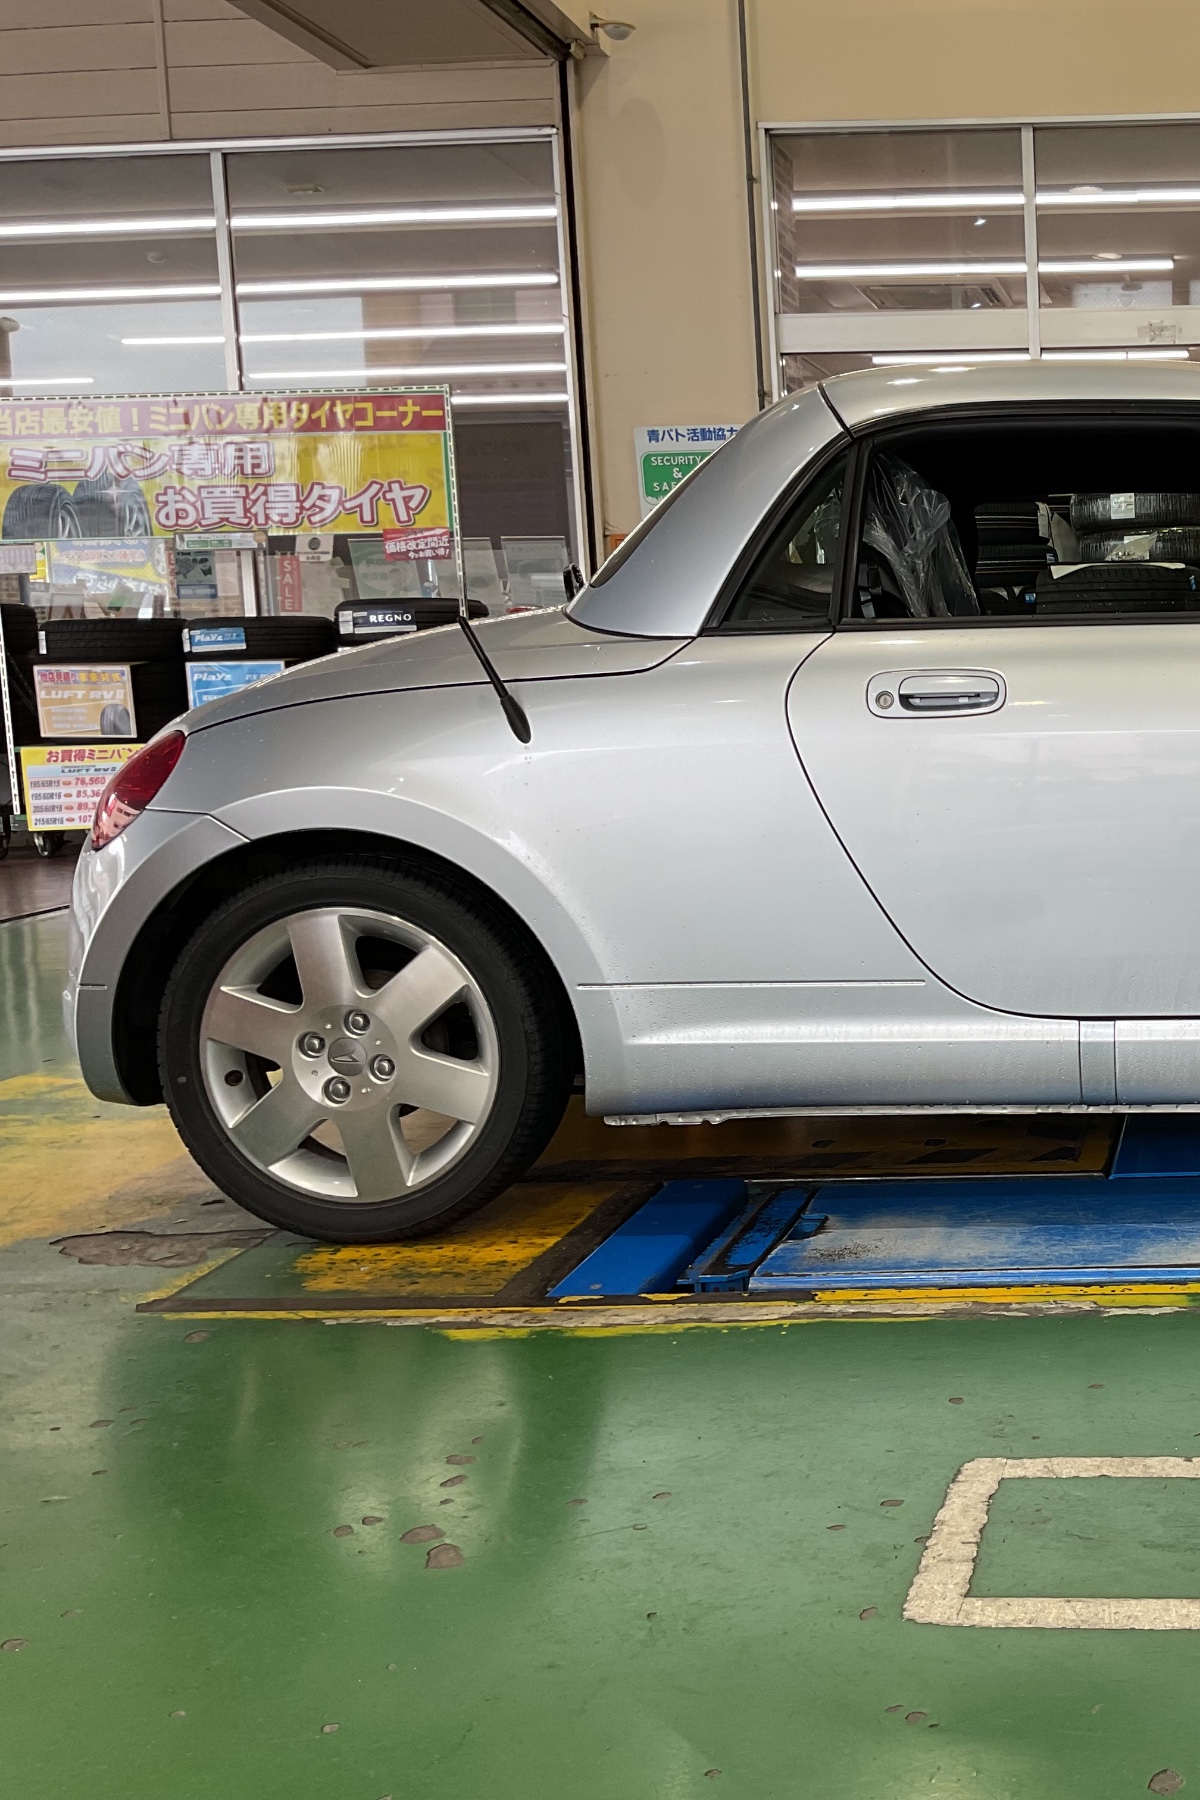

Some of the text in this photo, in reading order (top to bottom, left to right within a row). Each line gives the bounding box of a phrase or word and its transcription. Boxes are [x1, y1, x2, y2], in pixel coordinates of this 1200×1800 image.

[8, 441, 274, 483] ミニバン専用
[651, 456, 702, 466] SECURITY
[672, 467, 683, 479] &
[653, 482, 678, 492] SAF
[155, 479, 430, 529] お買得タイヤ
[283, 560, 294, 611] SALE
[369, 613, 412, 623] REGNO
[40, 690, 86, 699] LUFT
[46, 747, 141, 763] お買得ミニバン
[76, 789, 103, 799] 85,36
[77, 802, 97, 812] 89,3
[78, 814, 93, 823] 107
